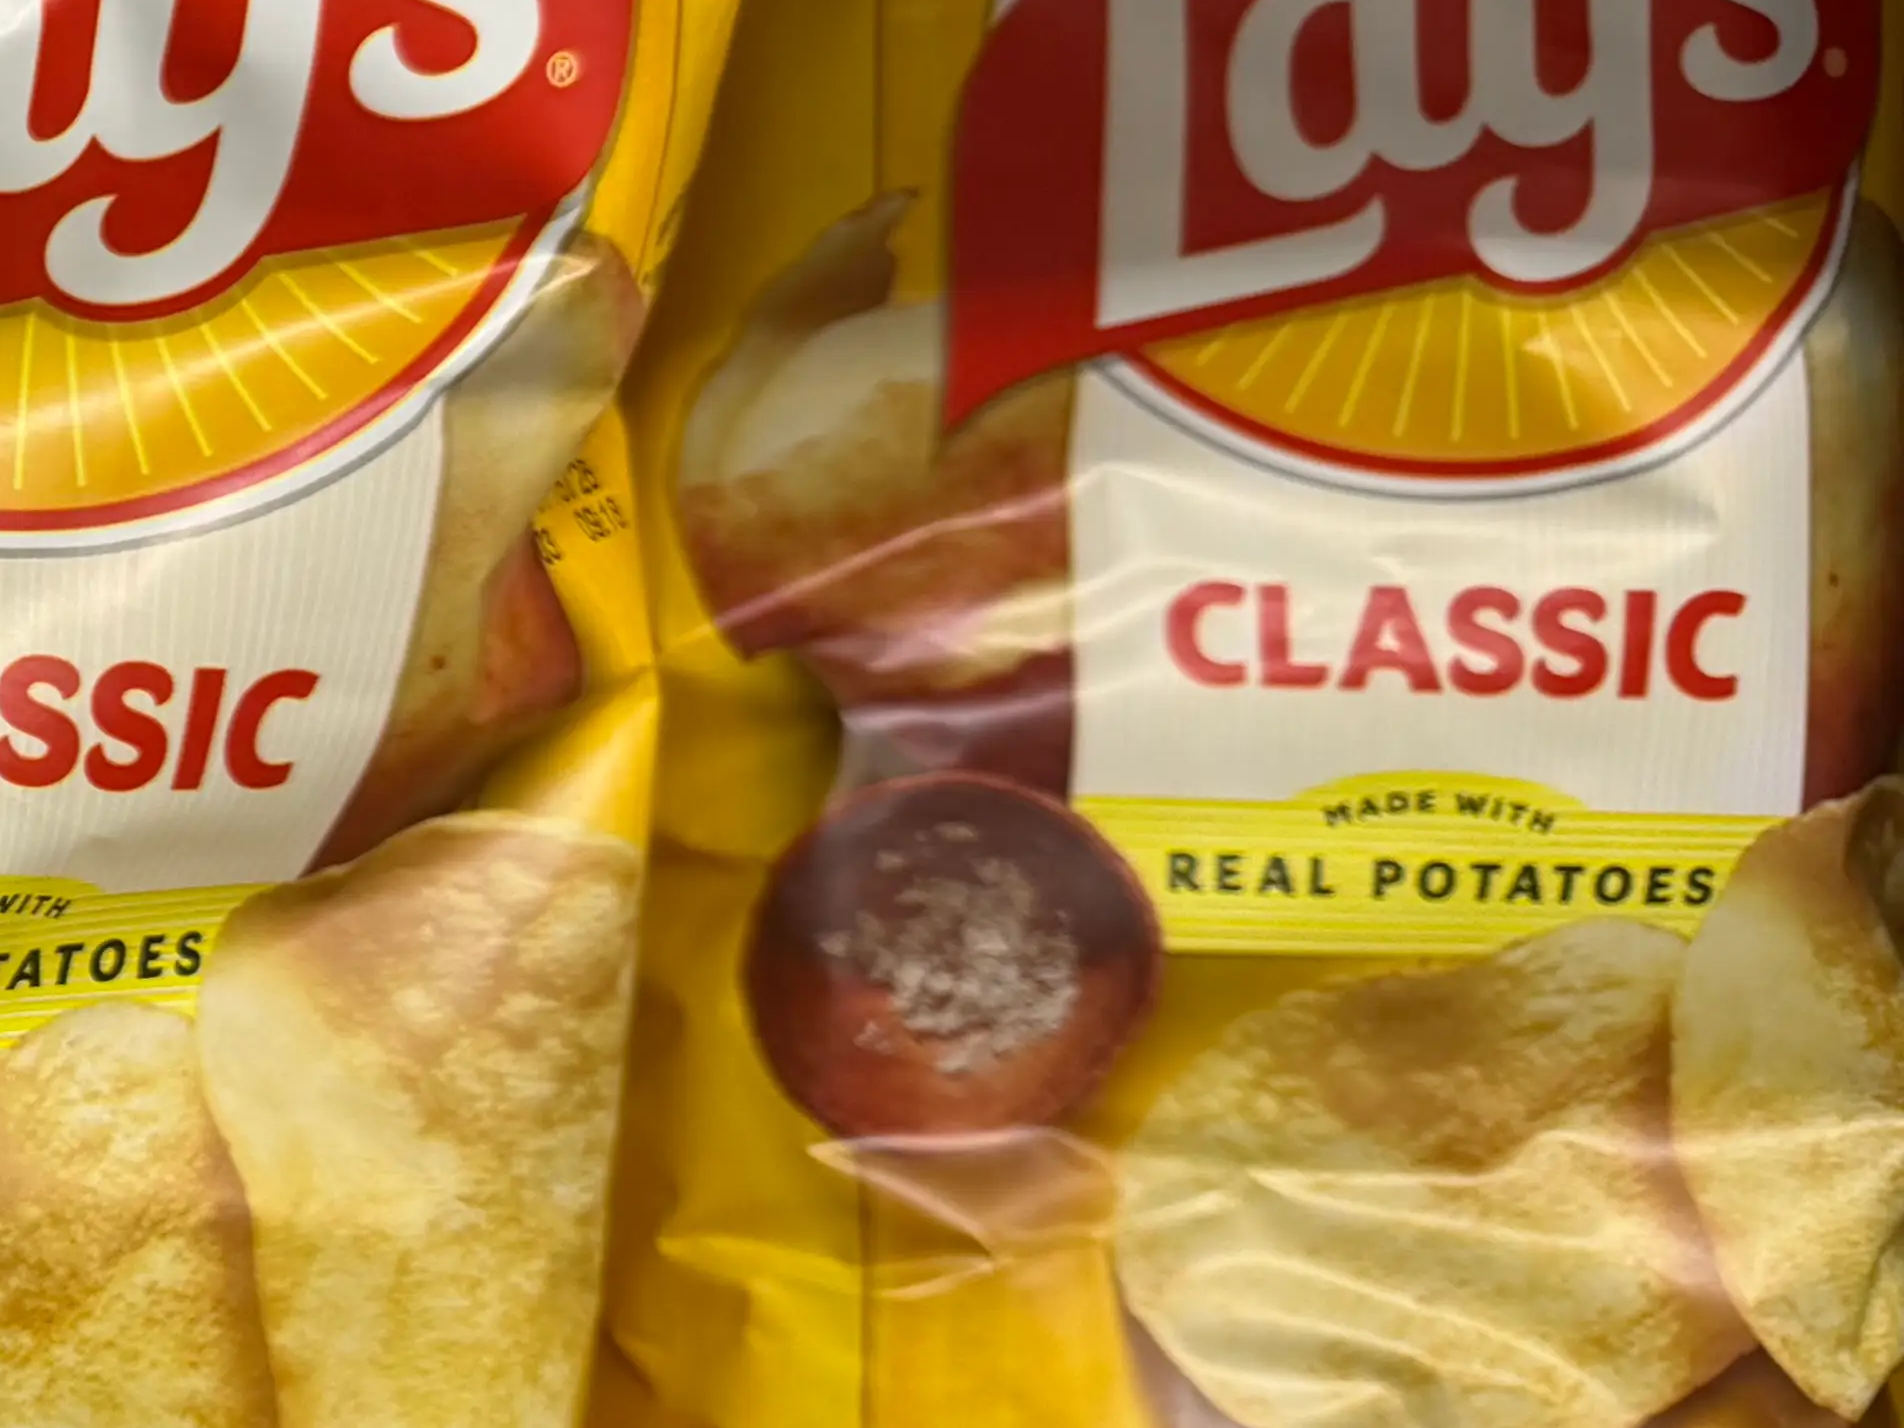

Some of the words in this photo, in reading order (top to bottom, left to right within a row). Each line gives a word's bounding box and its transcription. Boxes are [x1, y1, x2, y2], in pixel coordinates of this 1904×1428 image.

[1164, 579, 1749, 703] CLASSIC
[1322, 789, 1437, 829] MADE
[1455, 792, 1557, 835] WITH
[1167, 851, 1336, 897] REAL
[1373, 858, 1716, 907] POTATOES
